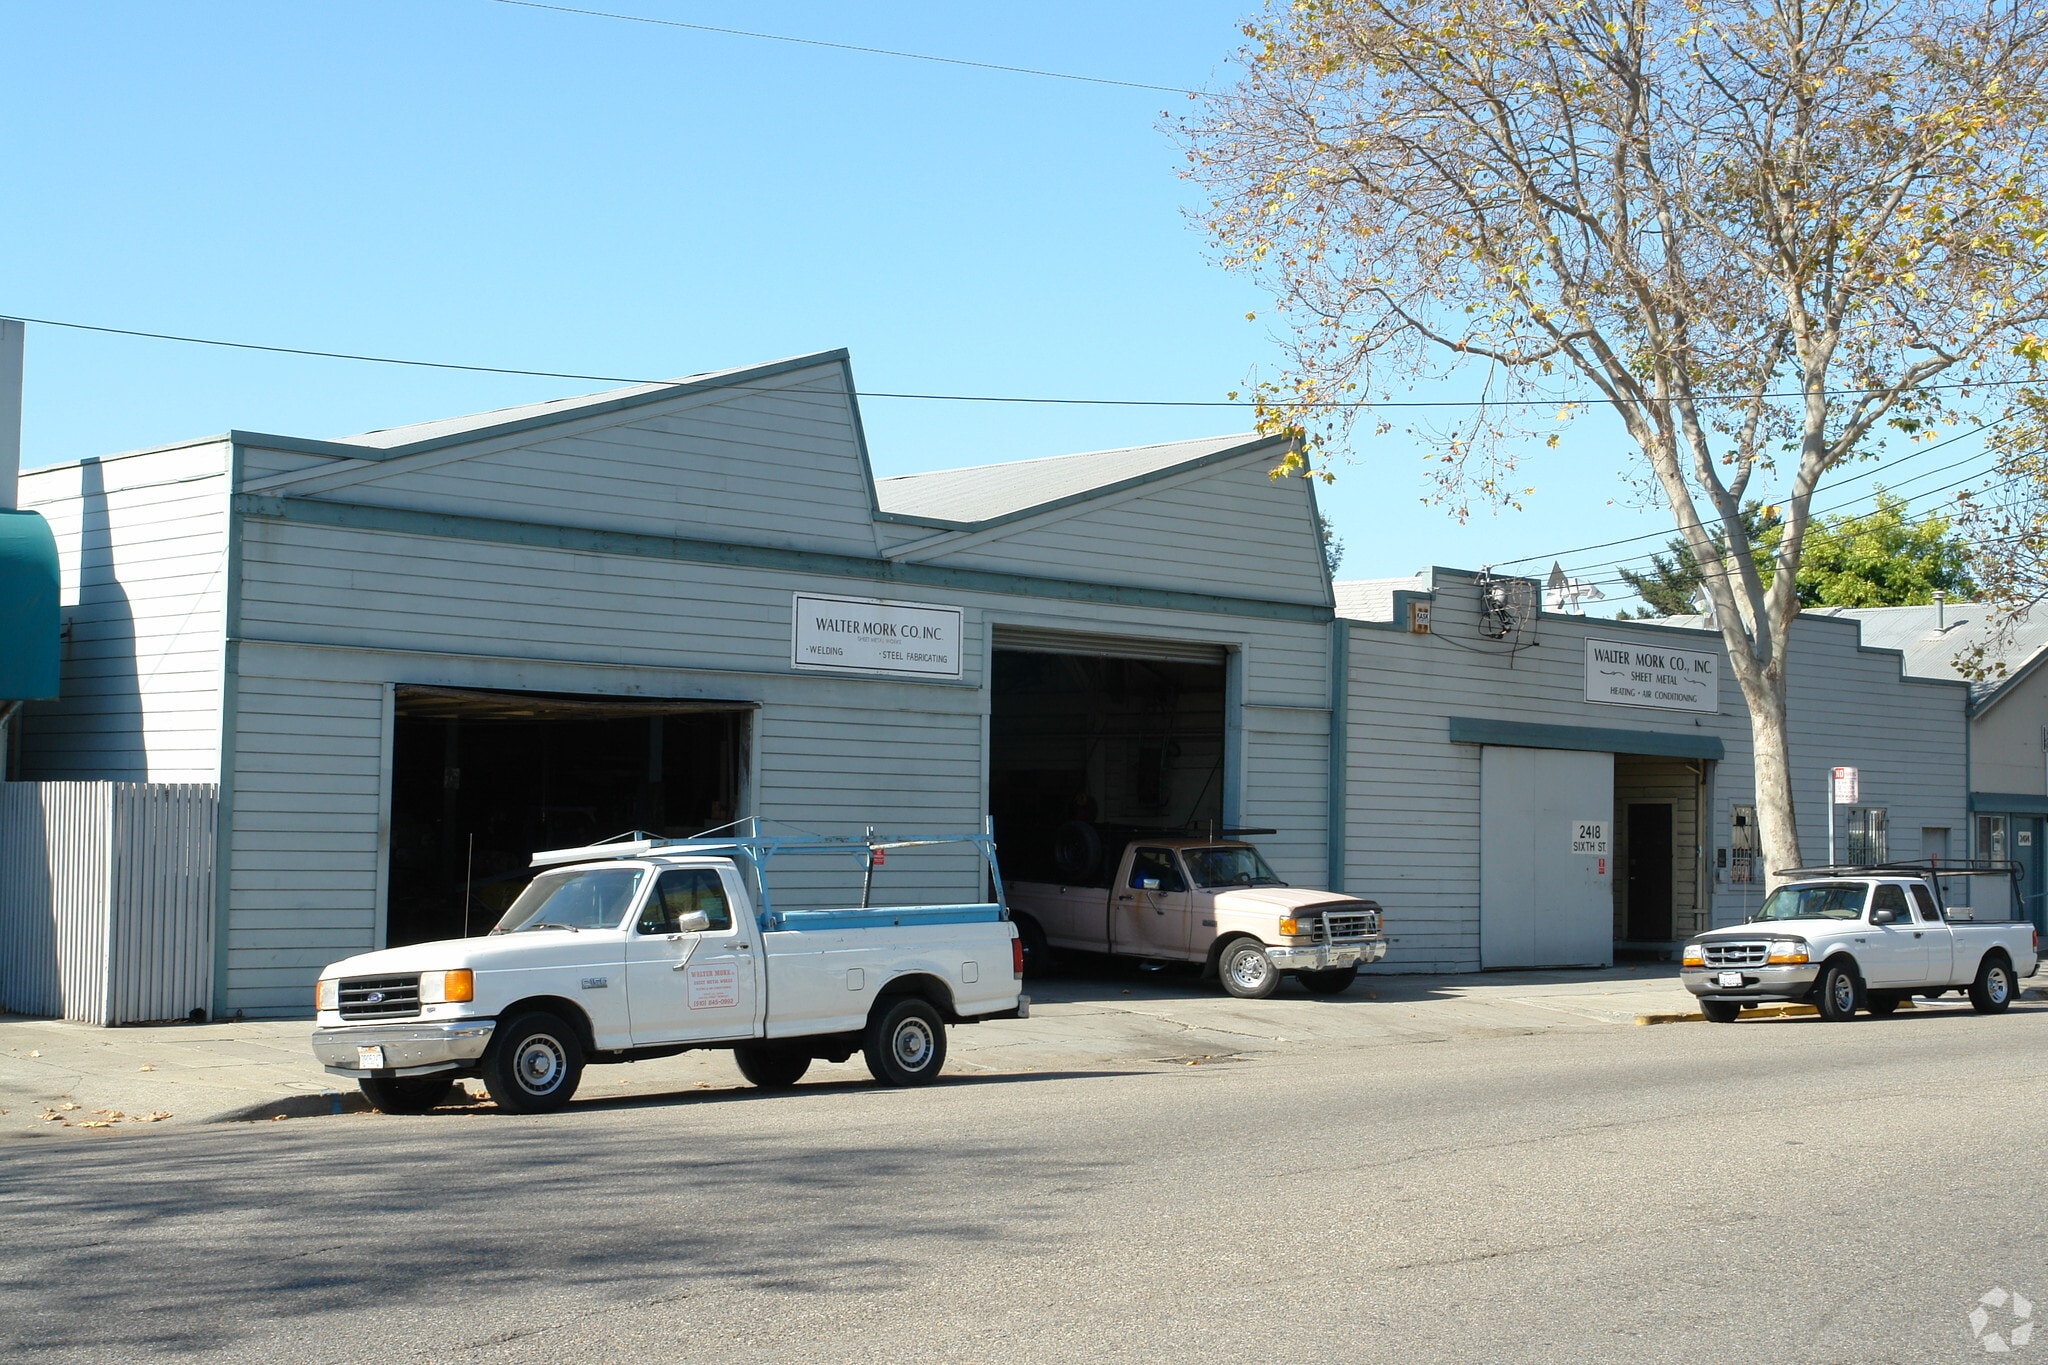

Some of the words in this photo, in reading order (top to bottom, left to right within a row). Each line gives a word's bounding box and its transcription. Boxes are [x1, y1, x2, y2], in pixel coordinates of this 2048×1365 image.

[816, 617, 860, 634] WALTER
[862, 622, 897, 637] MORK
[923, 626, 944, 641] INC.
[809, 645, 843, 656] WELDING
[882, 650, 904, 661] STEEL
[906, 652, 948, 664] FABRICATING
[1594, 648, 1630, 665] WALTER
[1635, 653, 1665, 669] MORK
[1631, 671, 1652, 683] SHEET
[1655, 675, 1678, 686] METAL
[1610, 686, 1636, 697] HEATING
[1642, 689, 1652, 699] AIR
[1654, 690, 1698, 703] CONDITIONING
[1579, 825, 1601, 839] 2418
[1573, 841, 1595, 852] SIXTH
